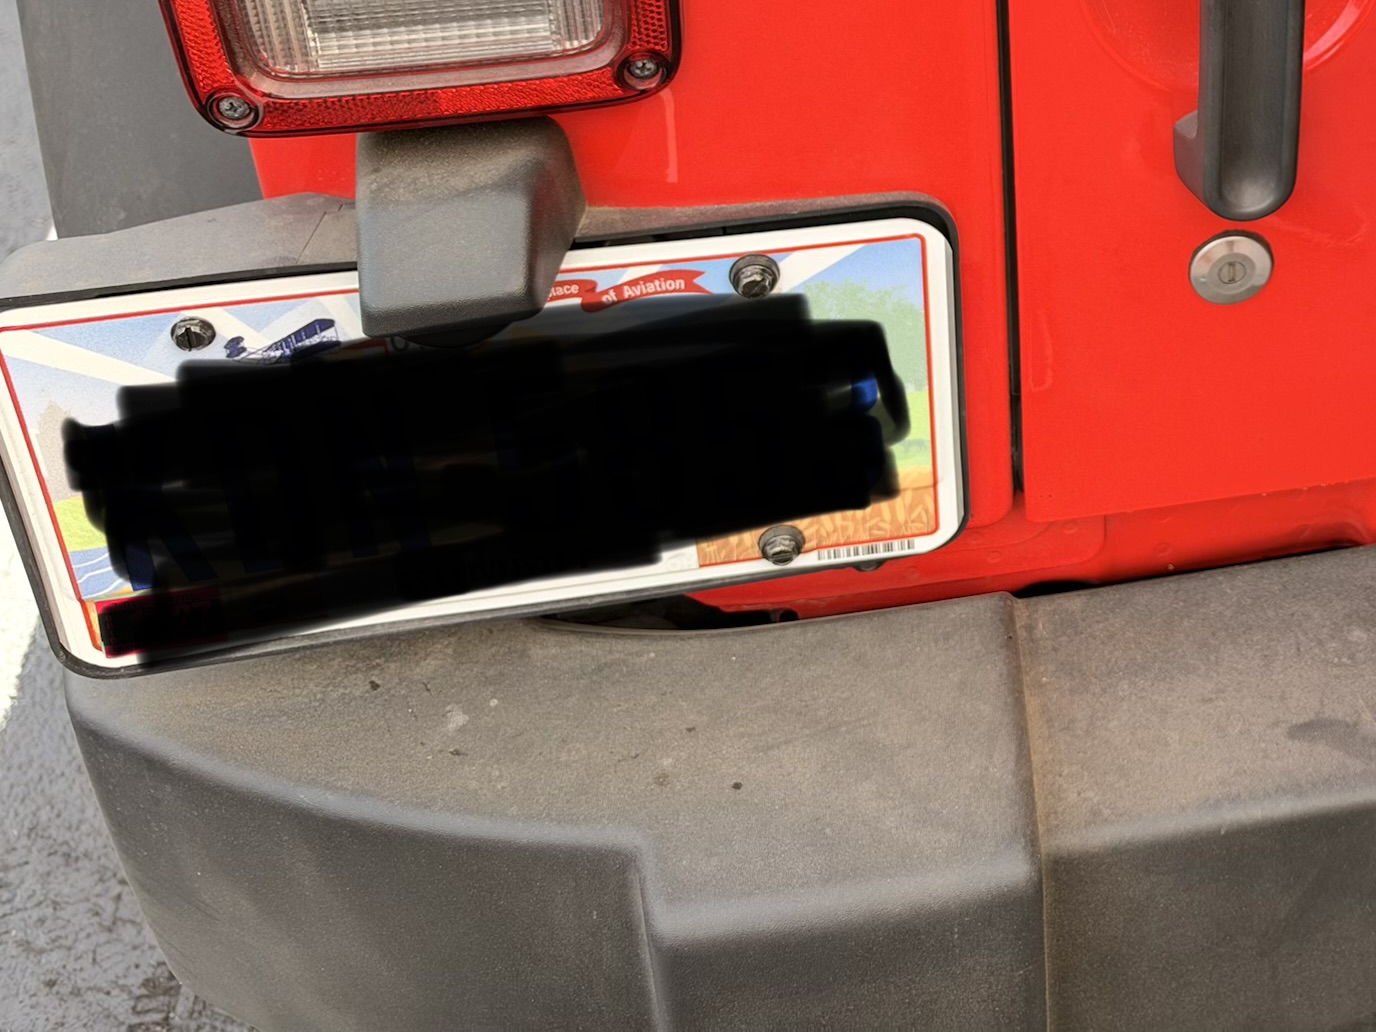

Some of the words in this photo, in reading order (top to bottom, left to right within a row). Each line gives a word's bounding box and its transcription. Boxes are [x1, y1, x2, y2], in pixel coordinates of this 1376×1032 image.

[547, 284, 579, 301] lace
[601, 289, 618, 304] of
[623, 278, 685, 299] Aviation
